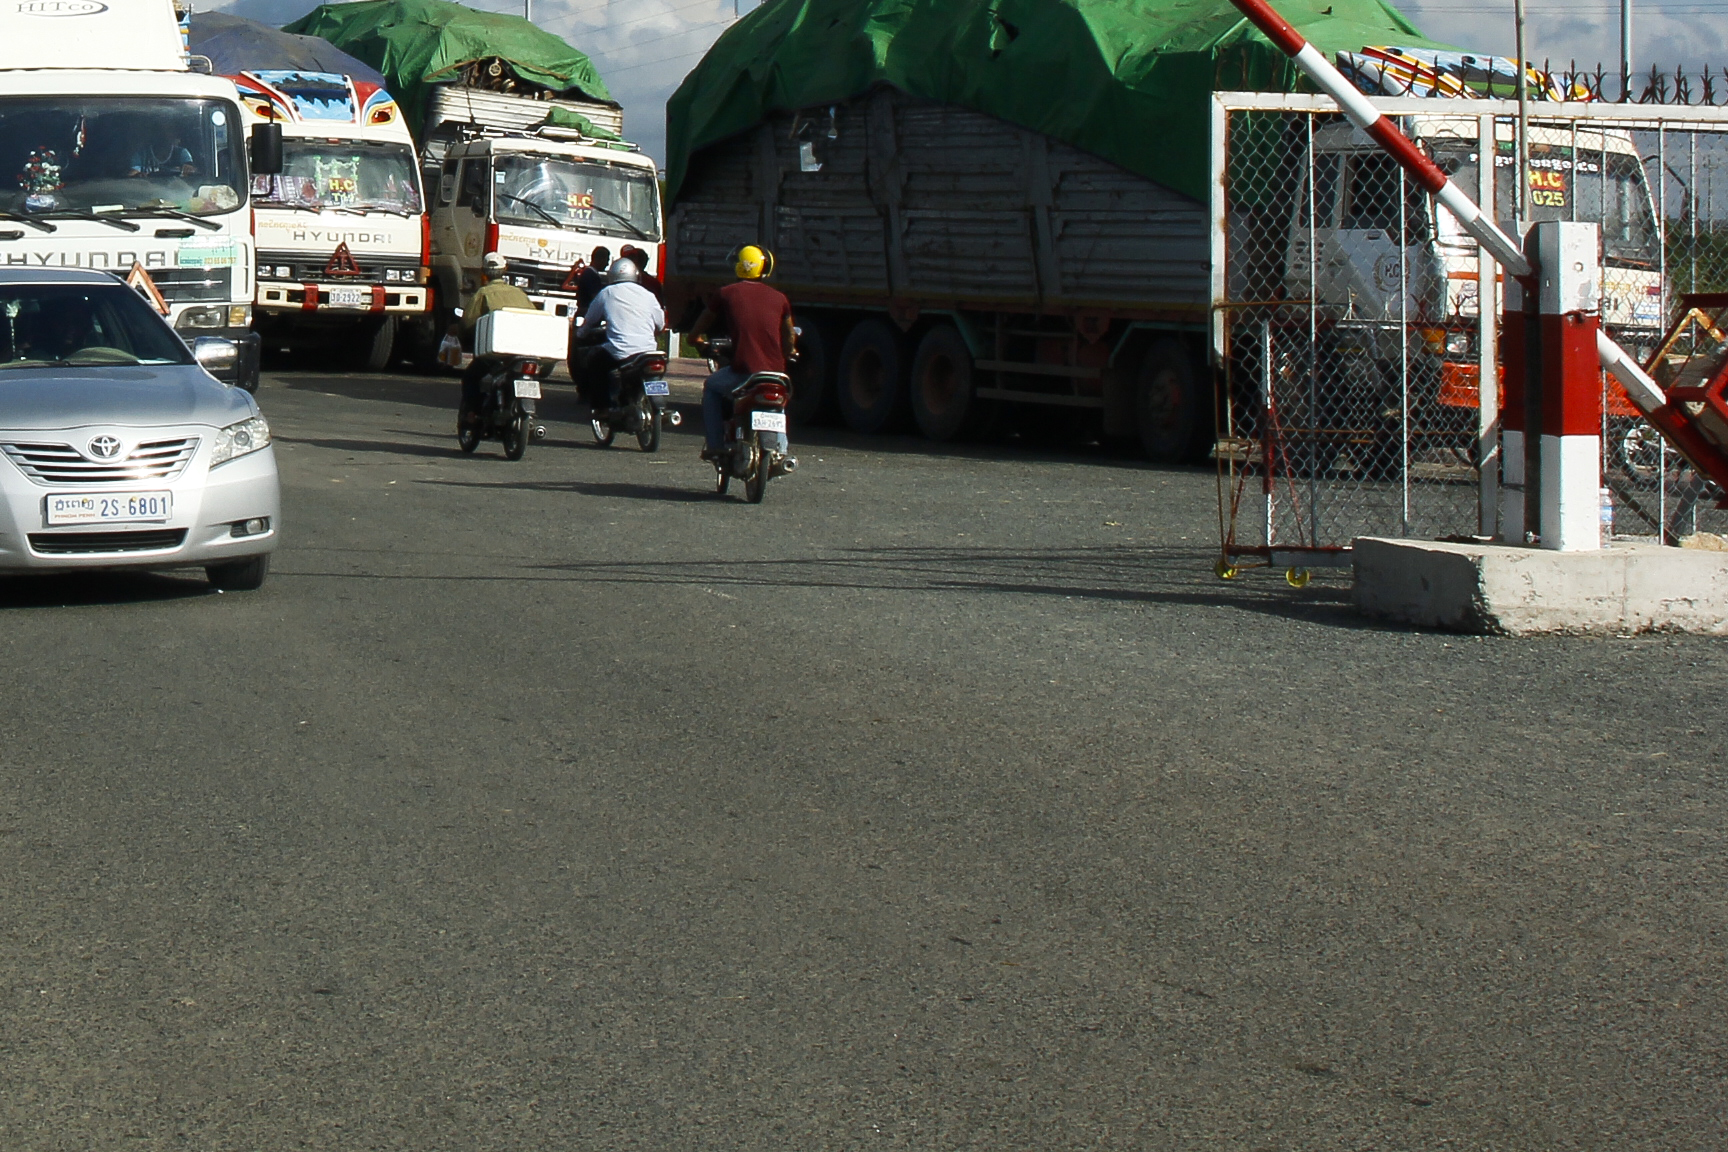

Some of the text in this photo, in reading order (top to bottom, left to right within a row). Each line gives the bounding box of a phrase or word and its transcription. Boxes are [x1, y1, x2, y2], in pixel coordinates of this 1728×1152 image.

[329, 179, 355, 191] H.C
[1529, 170, 1563, 187] H.C
[567, 194, 591, 208] H.C
[568, 208, 592, 219] T17
[293, 231, 392, 244] HYUNDAI
[100, 496, 167, 517] 2S-6801
